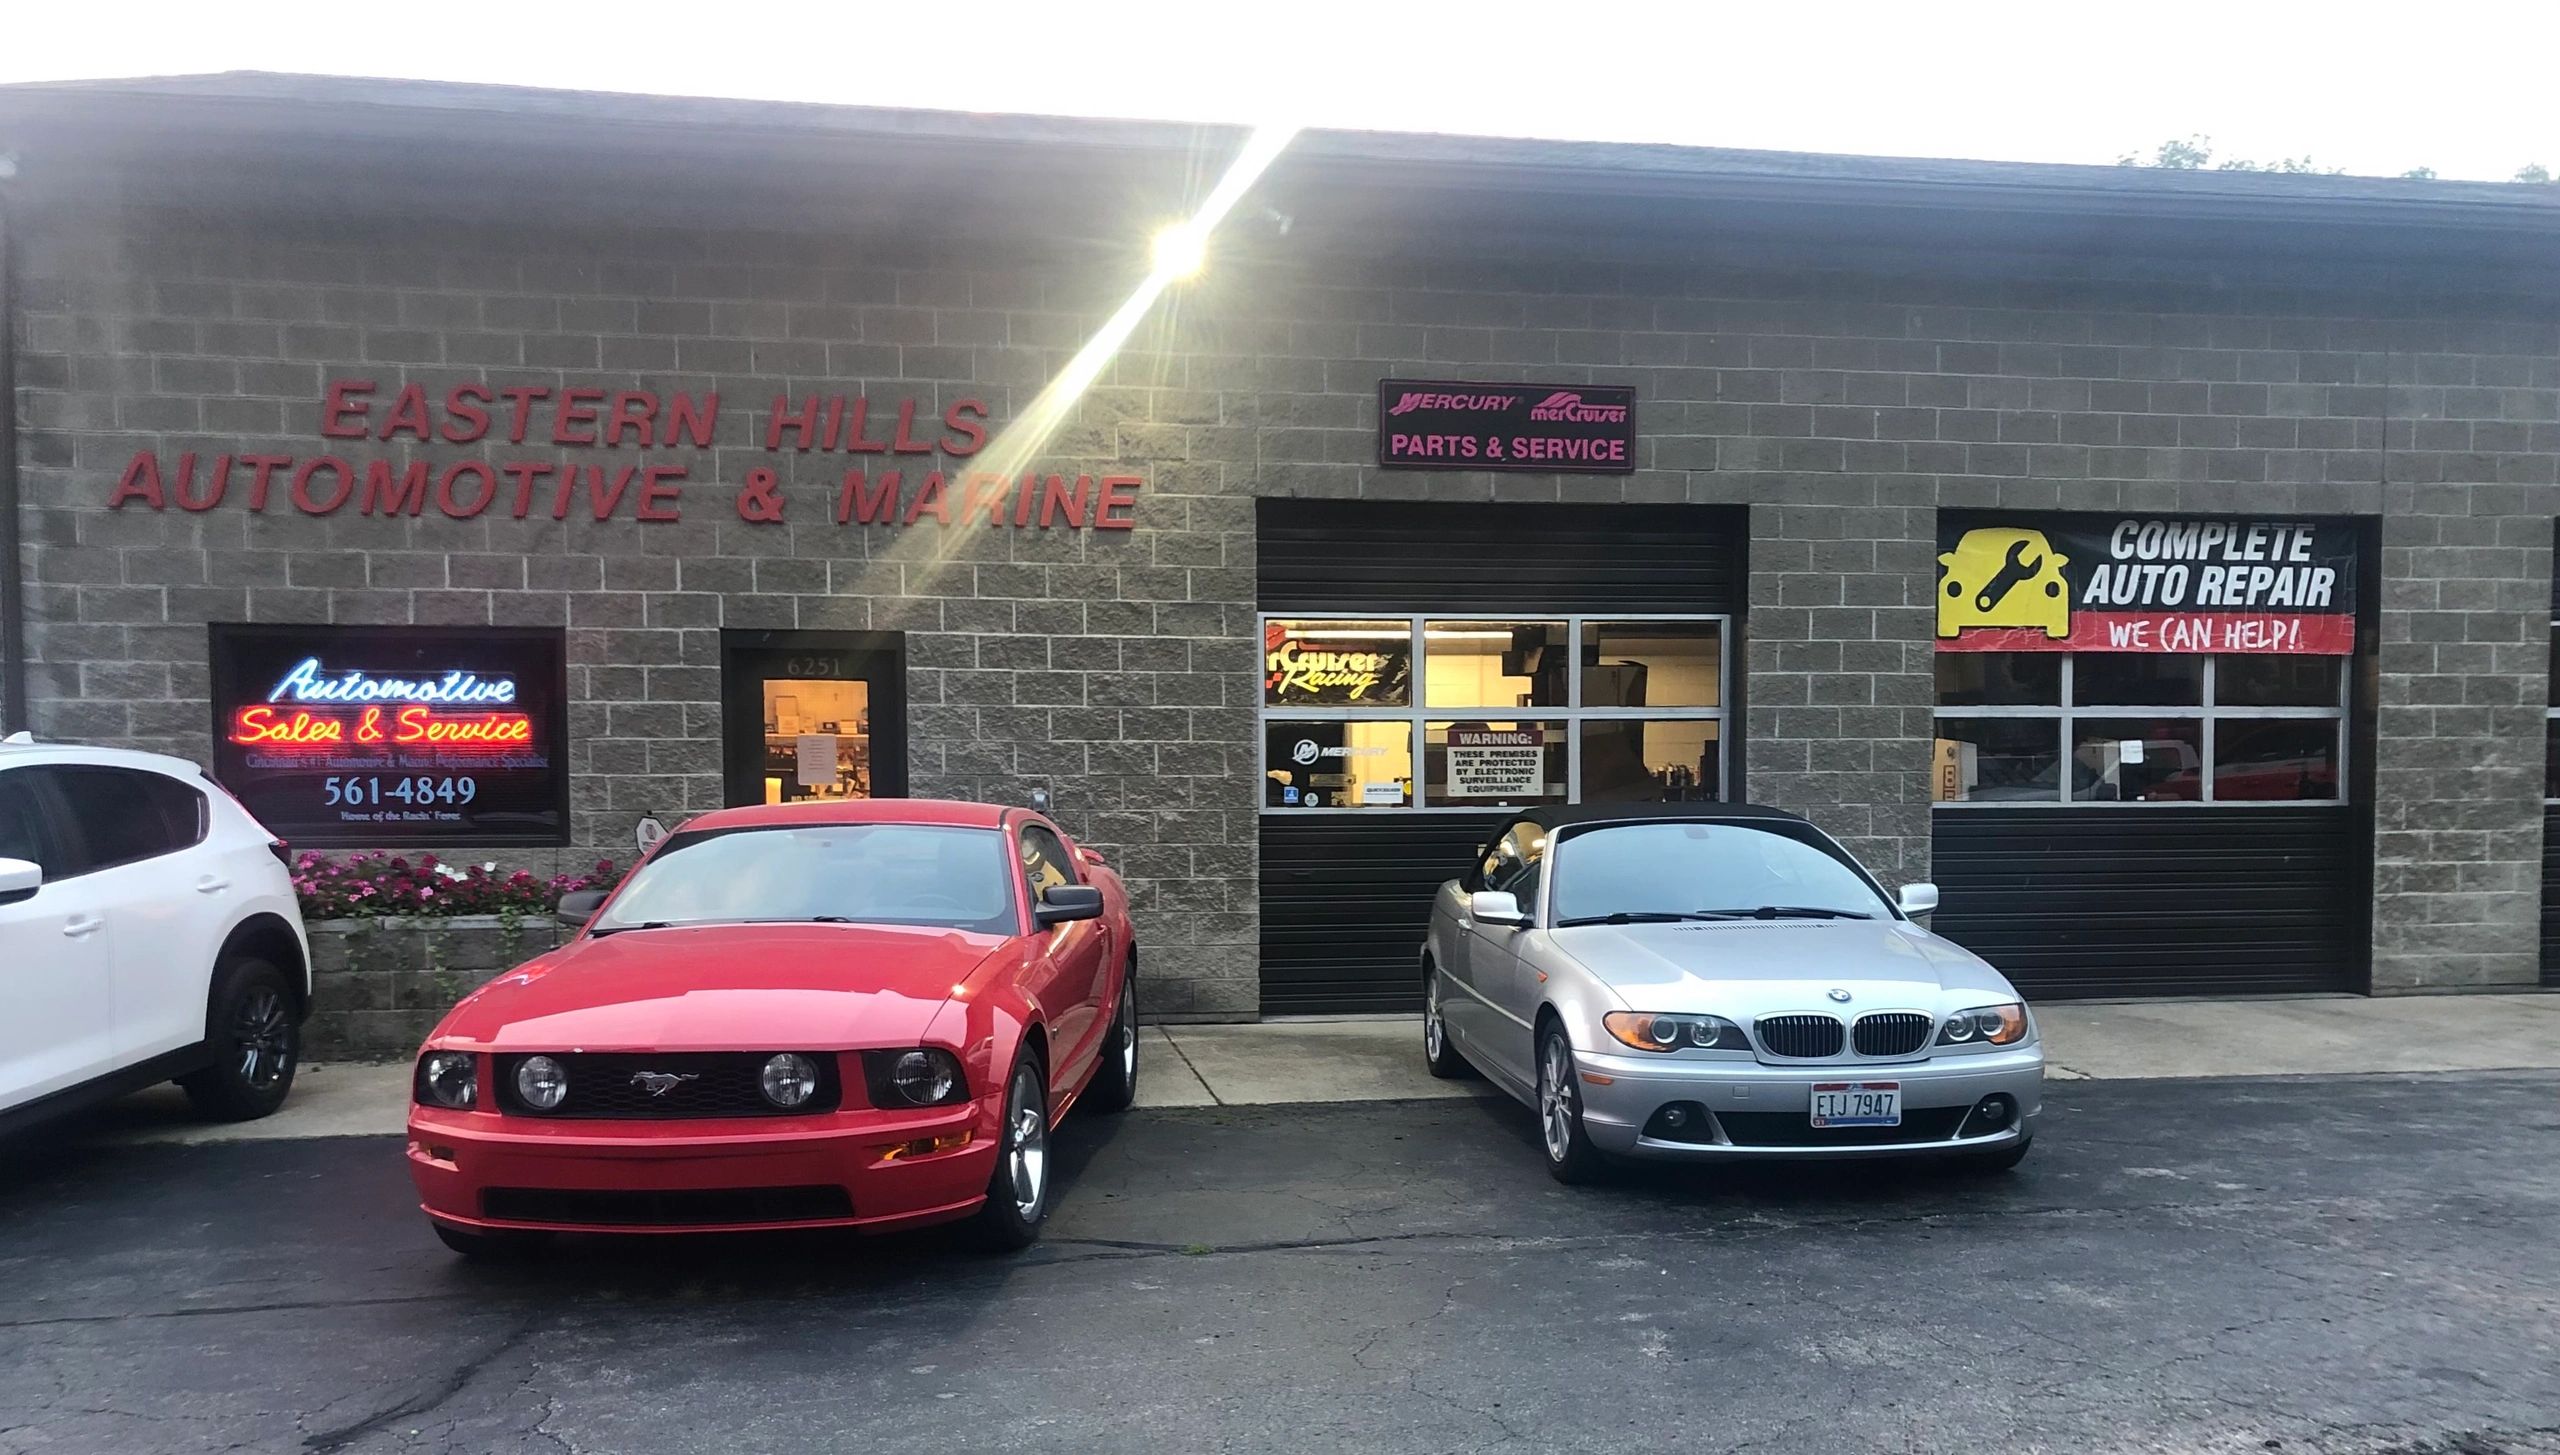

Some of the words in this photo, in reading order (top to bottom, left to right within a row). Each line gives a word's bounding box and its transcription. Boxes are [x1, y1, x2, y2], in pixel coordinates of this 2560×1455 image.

[321, 378, 719, 448] EASTERN
[766, 393, 990, 457] HILLS
[1389, 392, 1516, 416] MERCURY
[1391, 434, 1478, 457] PARTS
[1486, 436, 1503, 458] &
[1512, 437, 1626, 460] SERVICE
[108, 449, 688, 523] AUTOMOTIVE
[737, 466, 785, 523] &
[838, 470, 1143, 530] MARINE
[2110, 520, 2316, 562] COMPLETE
[2083, 564, 2190, 605] AUTO
[2196, 565, 2336, 607] REPAIR
[2109, 621, 2150, 648] WE
[2160, 617, 2213, 652] CAN
[2225, 619, 2301, 651] HELP!
[787, 657, 840, 676] 6251
[1267, 640, 1377, 672] rCruiser
[268, 657, 516, 703] Automotive
[1277, 668, 1379, 700] Racing
[238, 707, 342, 743] Sales
[357, 707, 383, 742] &
[396, 707, 529, 742] Service
[1459, 732, 1533, 745] WARNING:
[1454, 750, 1485, 758] THESE
[1489, 750, 1538, 758] PREMISES
[1455, 759, 1474, 767] ARE
[1479, 759, 1537, 767] PROTECTED
[1456, 768, 1469, 776] BY
[1475, 768, 1536, 776] ELECTRONIC
[1459, 776, 1532, 785] SURVEILLANCE
[324, 776, 476, 806] 561-4849
[372, 811, 385, 823] of
[385, 811, 400, 821] the
[1817, 1095, 1848, 1117] EIJ
[1854, 1094, 1894, 1116] 7947
